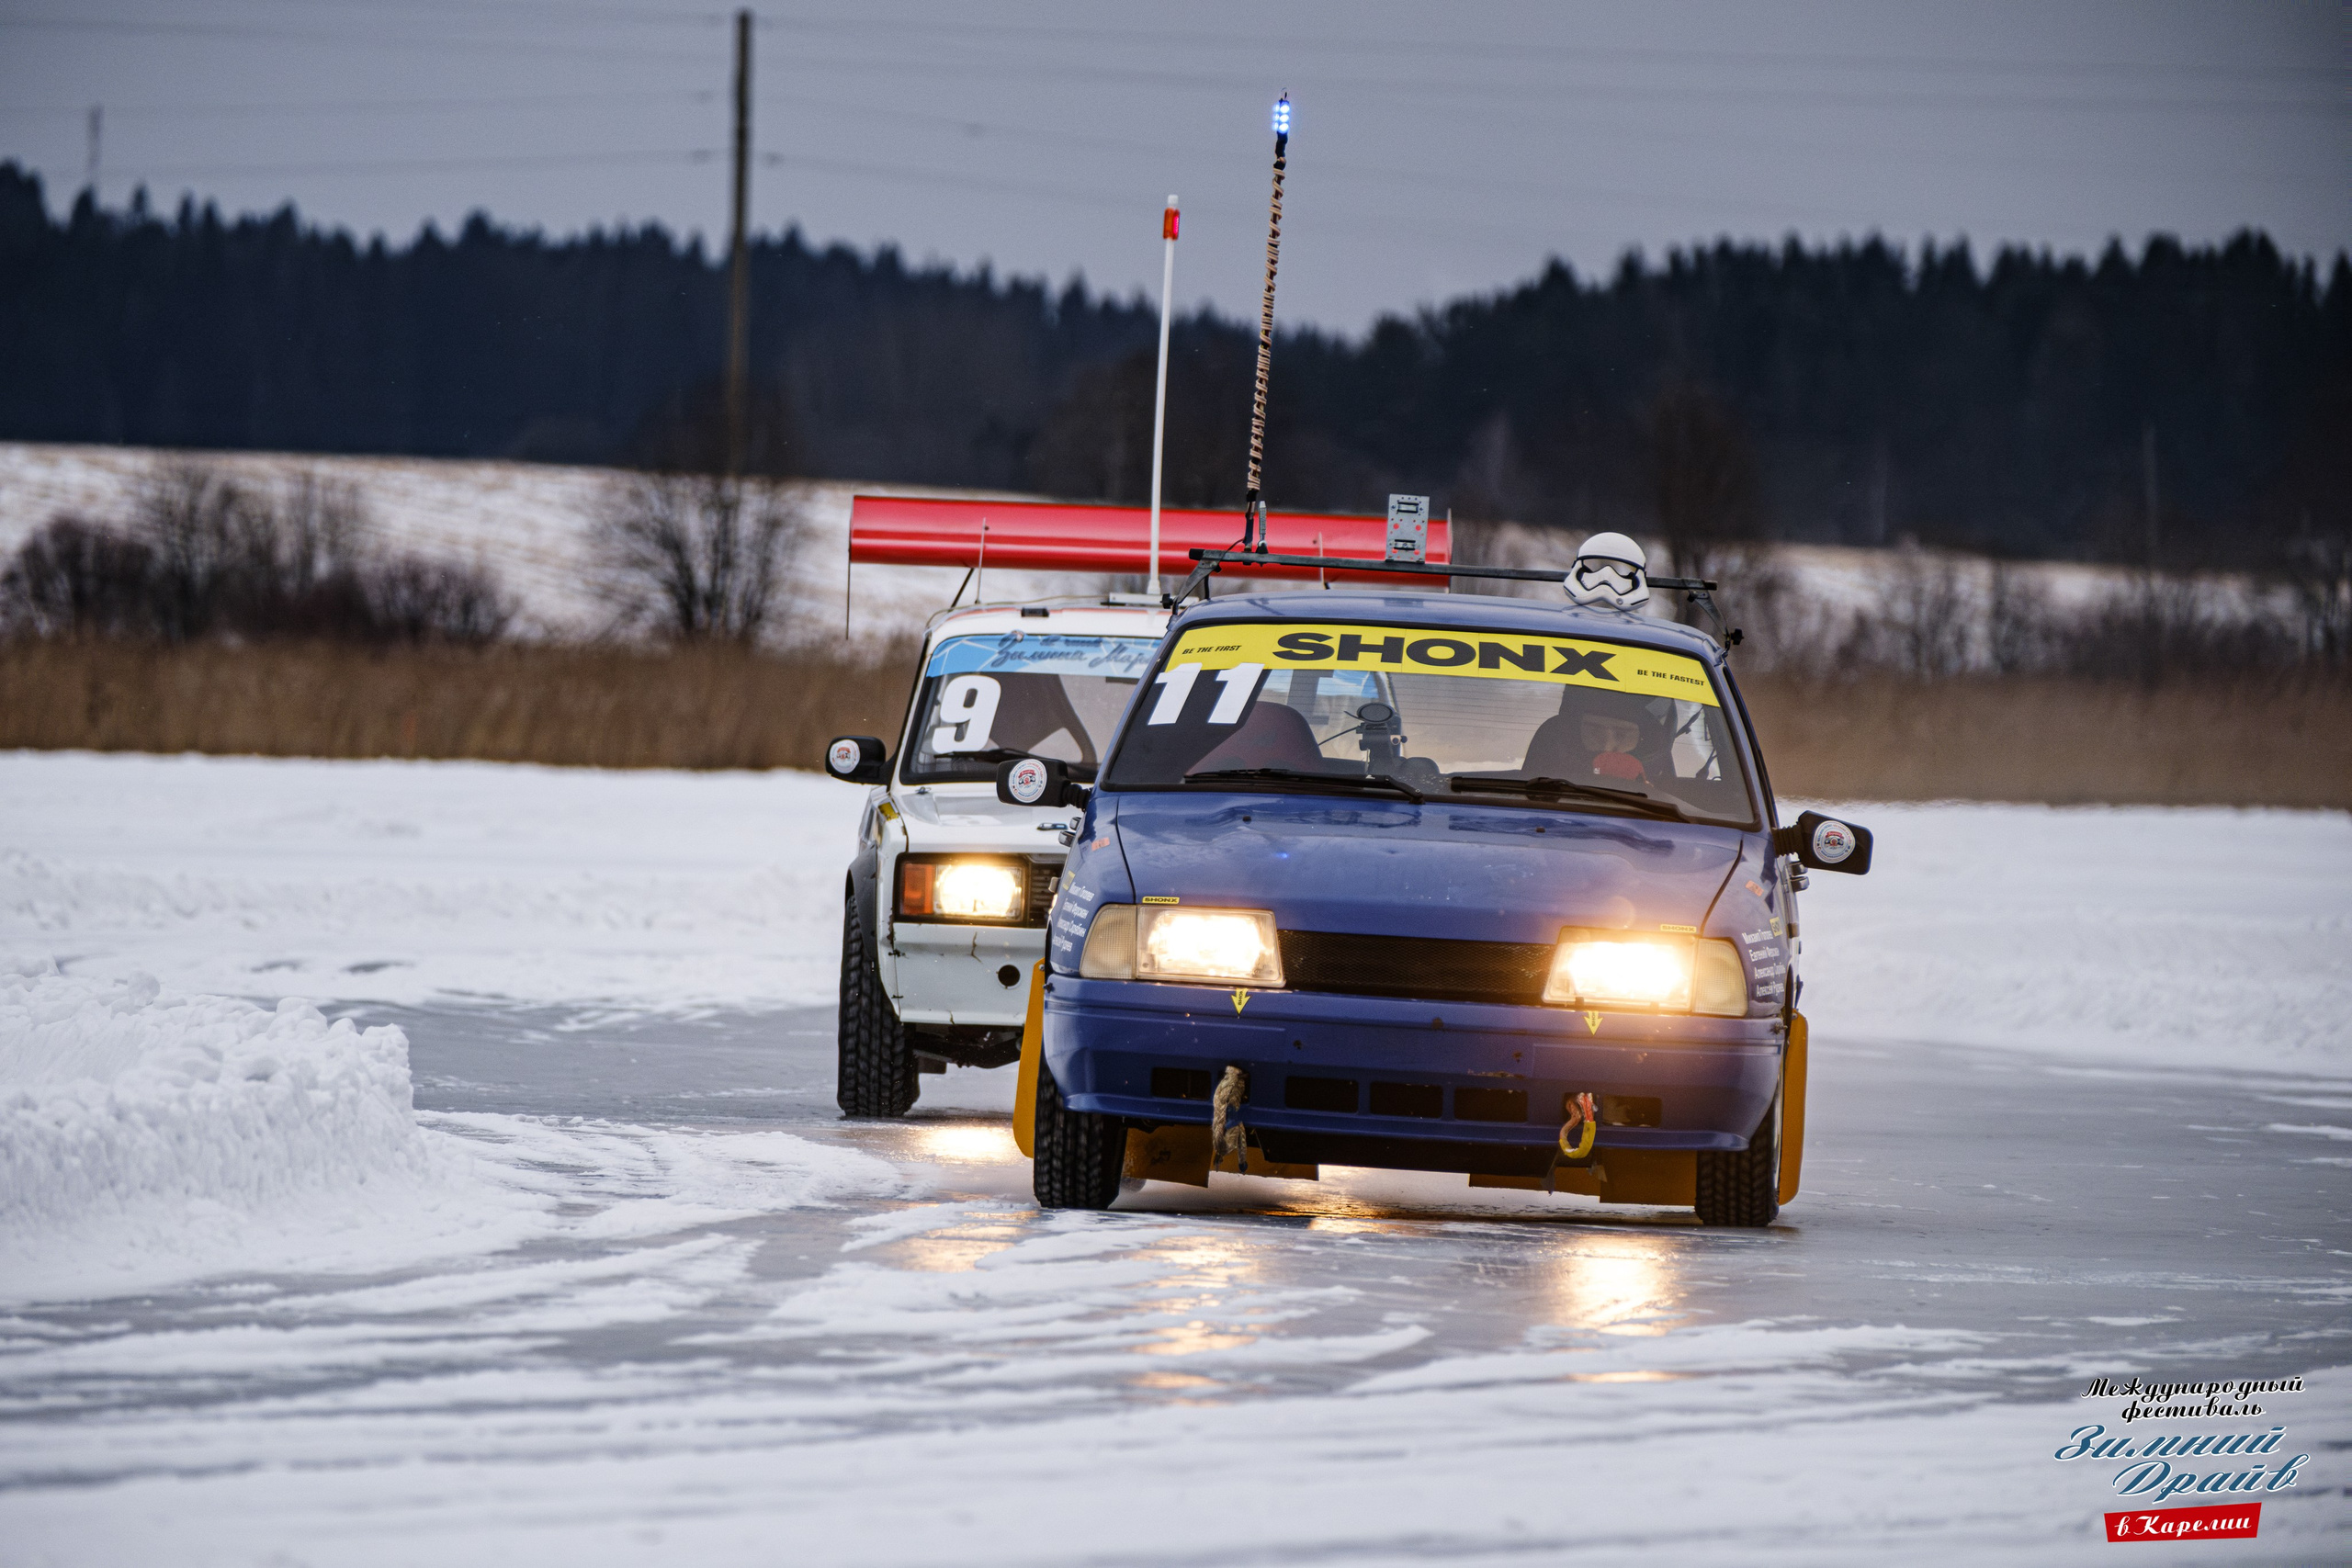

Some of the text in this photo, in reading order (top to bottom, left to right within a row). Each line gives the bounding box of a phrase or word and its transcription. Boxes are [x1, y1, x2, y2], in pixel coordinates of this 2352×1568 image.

[1272, 632, 1620, 682] SHONX
[1651, 671, 1668, 679] THE
[1669, 673, 1705, 686] FASTEST
[932, 675, 1001, 753] 9
[1148, 662, 1265, 725] 11
[1661, 924, 1696, 932] SHONX
